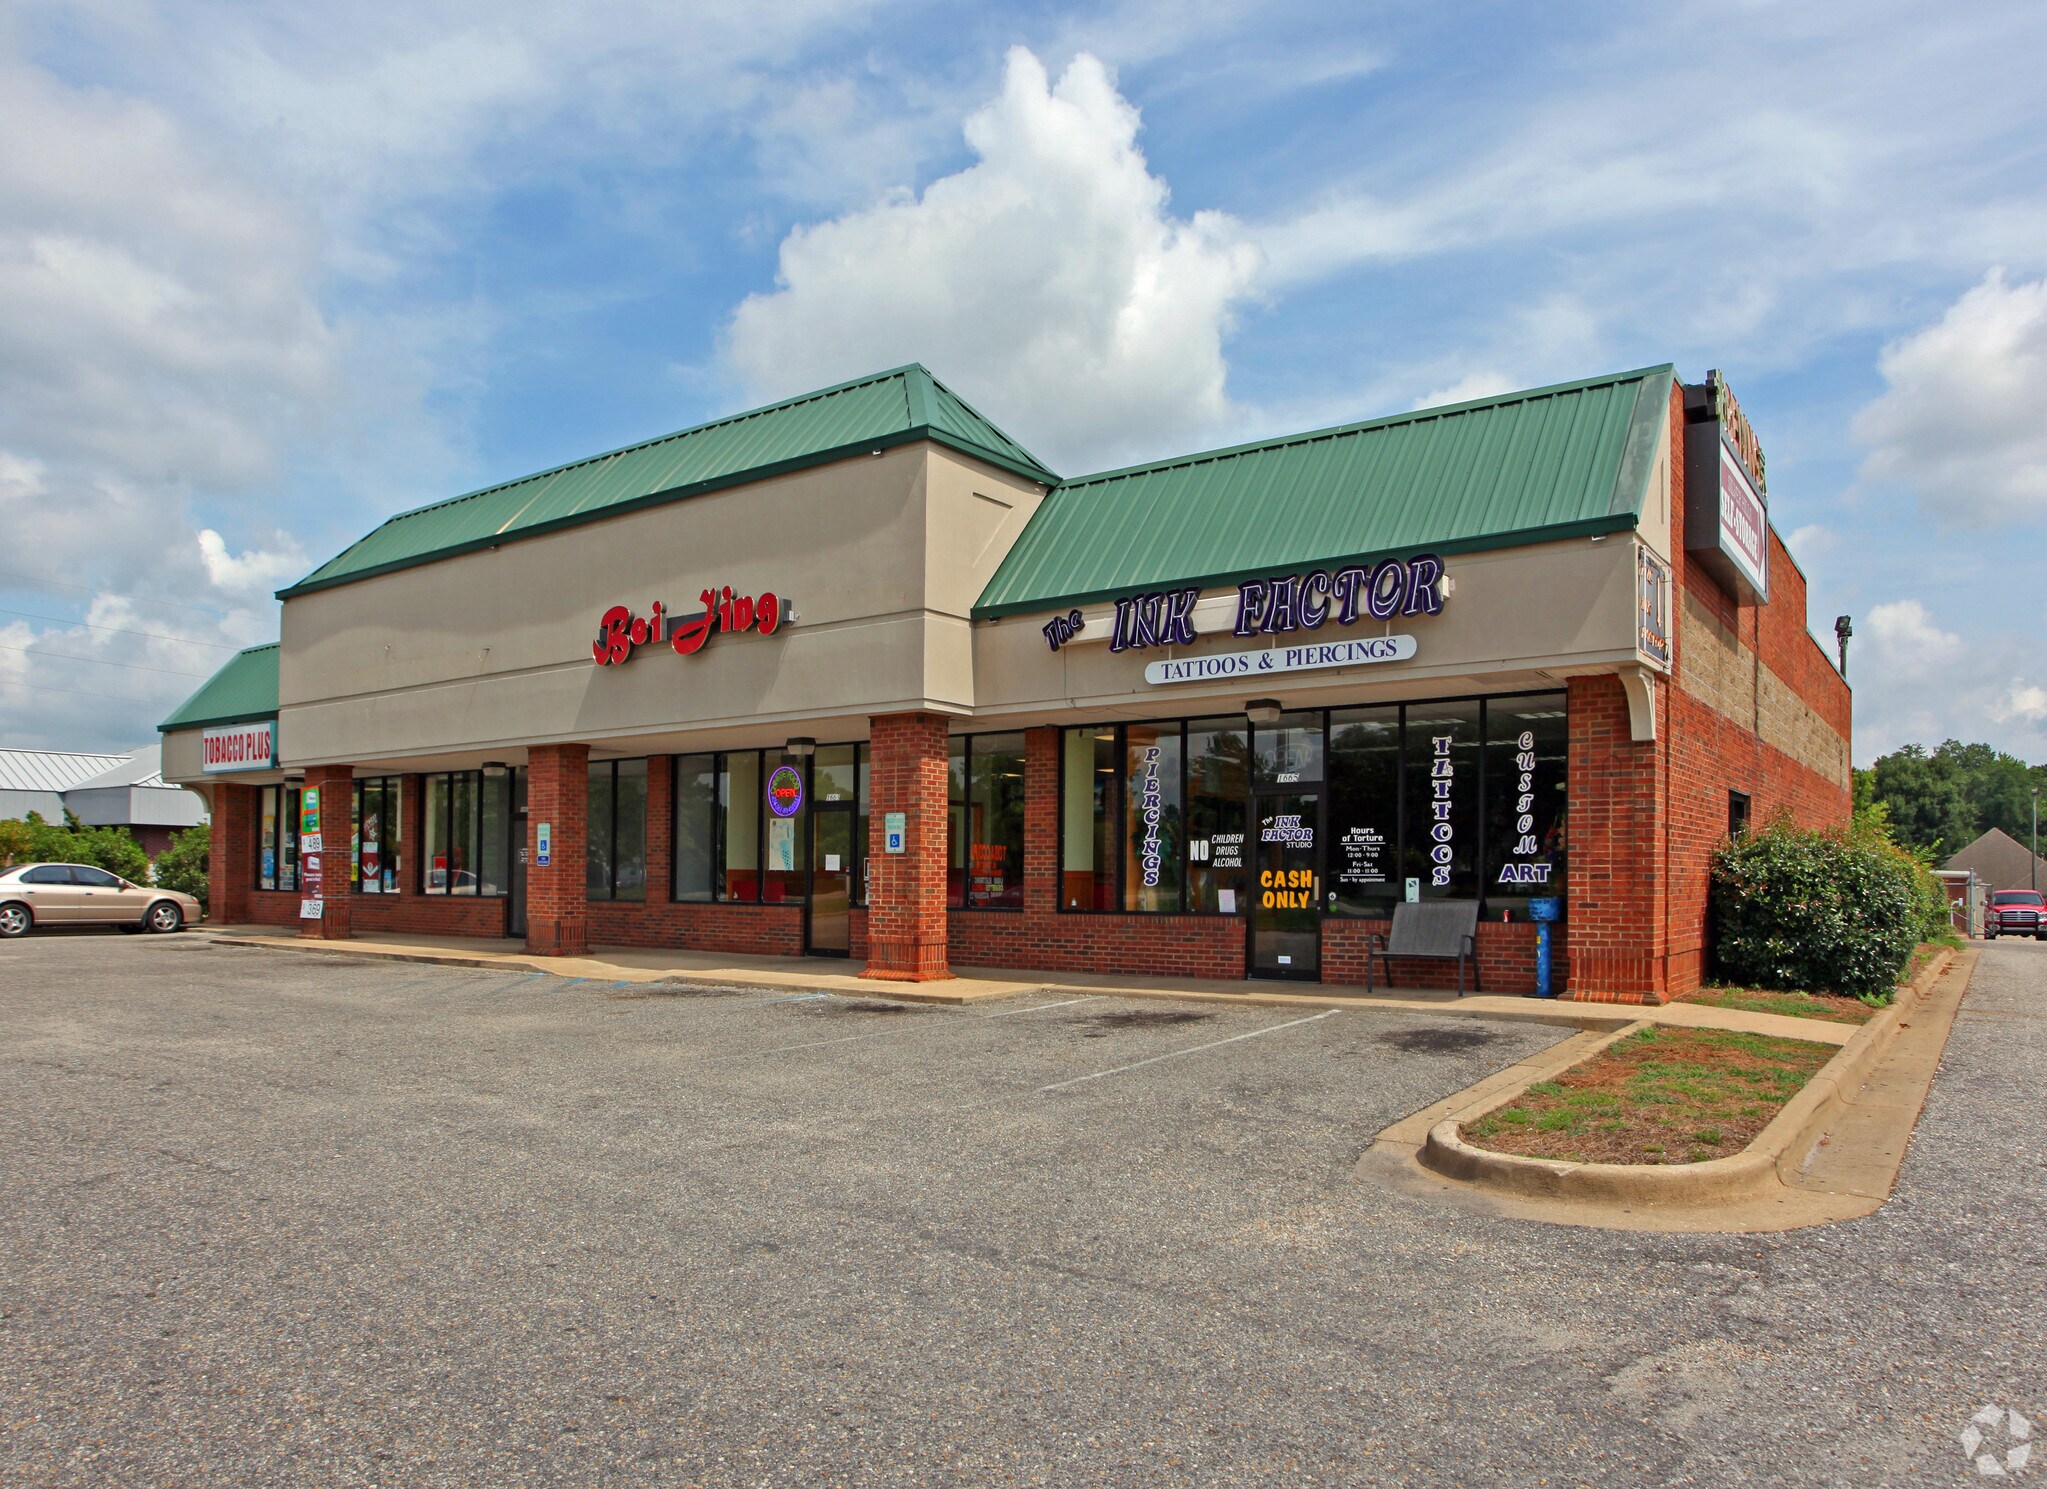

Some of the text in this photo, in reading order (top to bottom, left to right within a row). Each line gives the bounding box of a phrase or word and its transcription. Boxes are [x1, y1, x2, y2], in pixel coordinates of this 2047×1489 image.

[1720, 486, 1758, 561] SELF-STORAGE
[1042, 553, 1445, 653] The INK FACTOR
[593, 585, 782, 666] Bei Jing
[1161, 639, 1397, 680] TATTOOS & PIERCINGS
[204, 731, 270, 764] TOBACCO PLUS
[775, 788, 796, 797] OPEN
[1513, 731, 1537, 854] CUSTOM
[1142, 747, 1161, 886] PIERCINGS
[1431, 736, 1453, 886] TATTOOS
[1262, 815, 1301, 828] The INK
[1211, 834, 1244, 844] CHILDREN
[1261, 828, 1313, 841] FACTOR
[1190, 840, 1209, 860] NO
[1216, 846, 1238, 855] DRUGS
[1213, 857, 1242, 867] ALCOHOL
[1261, 870, 1312, 888] CASH
[1498, 864, 1551, 883] ART
[1263, 890, 1309, 908] ONLY
